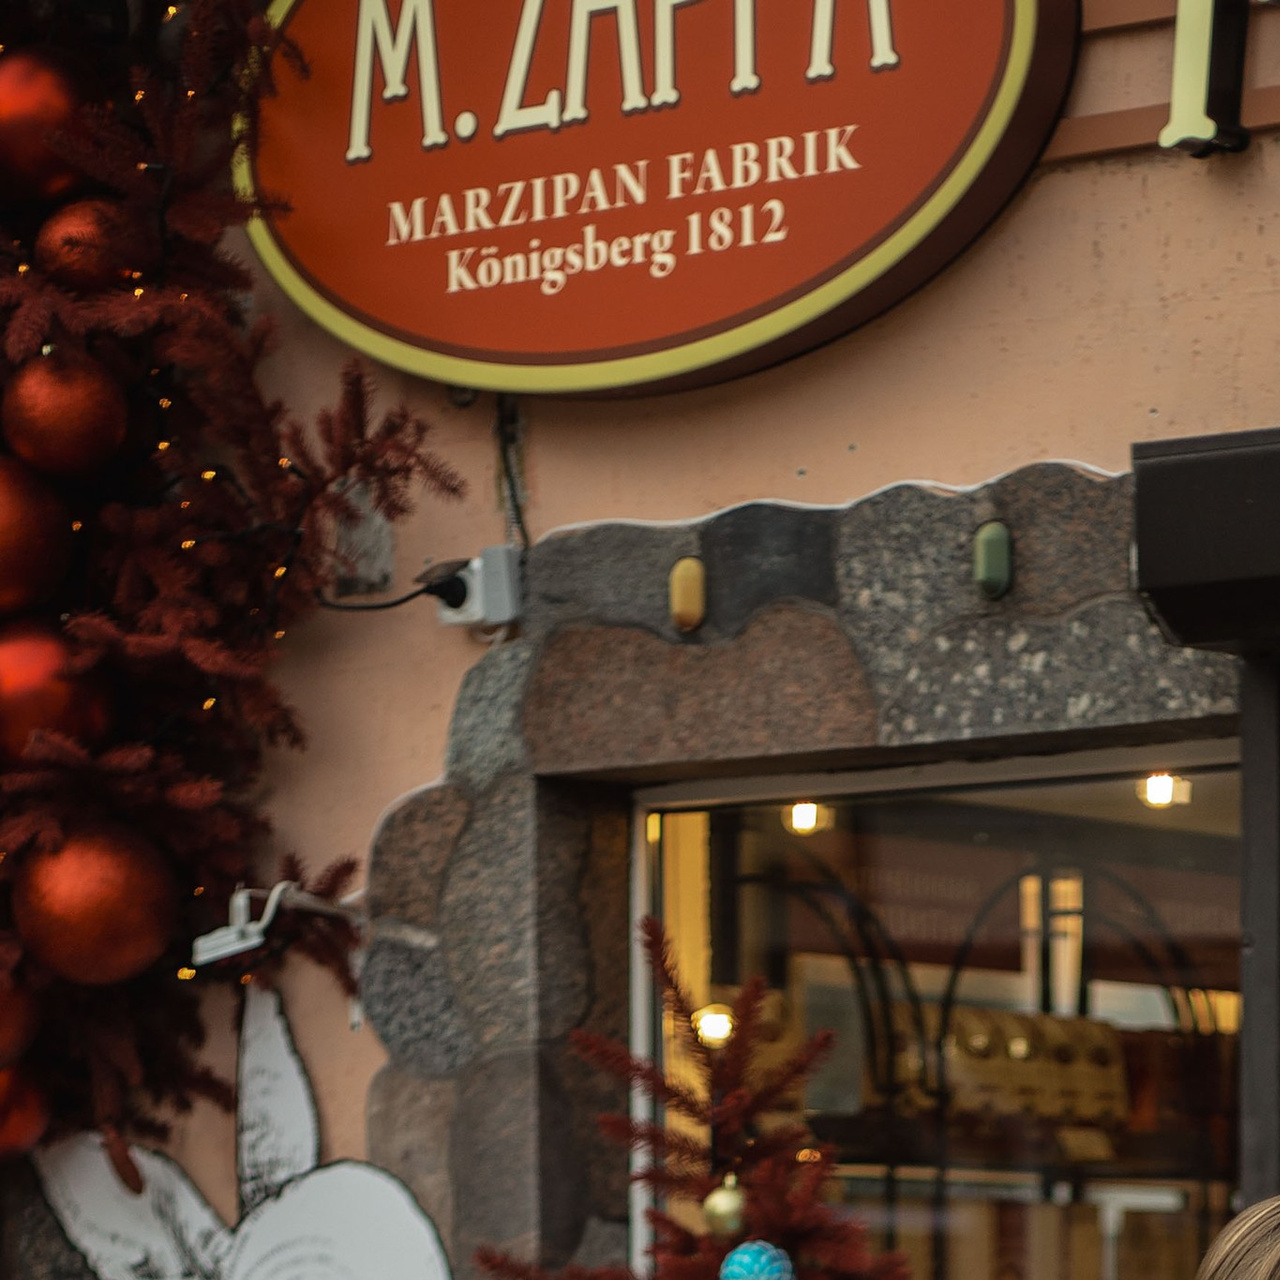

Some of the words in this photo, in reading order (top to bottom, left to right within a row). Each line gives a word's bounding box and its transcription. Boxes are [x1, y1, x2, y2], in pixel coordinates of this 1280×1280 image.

[385, 159, 649, 247] MARZIPAN
[666, 123, 863, 200] FABRIK
[445, 216, 677, 295] Königsberg
[685, 198, 789, 257] 1812
